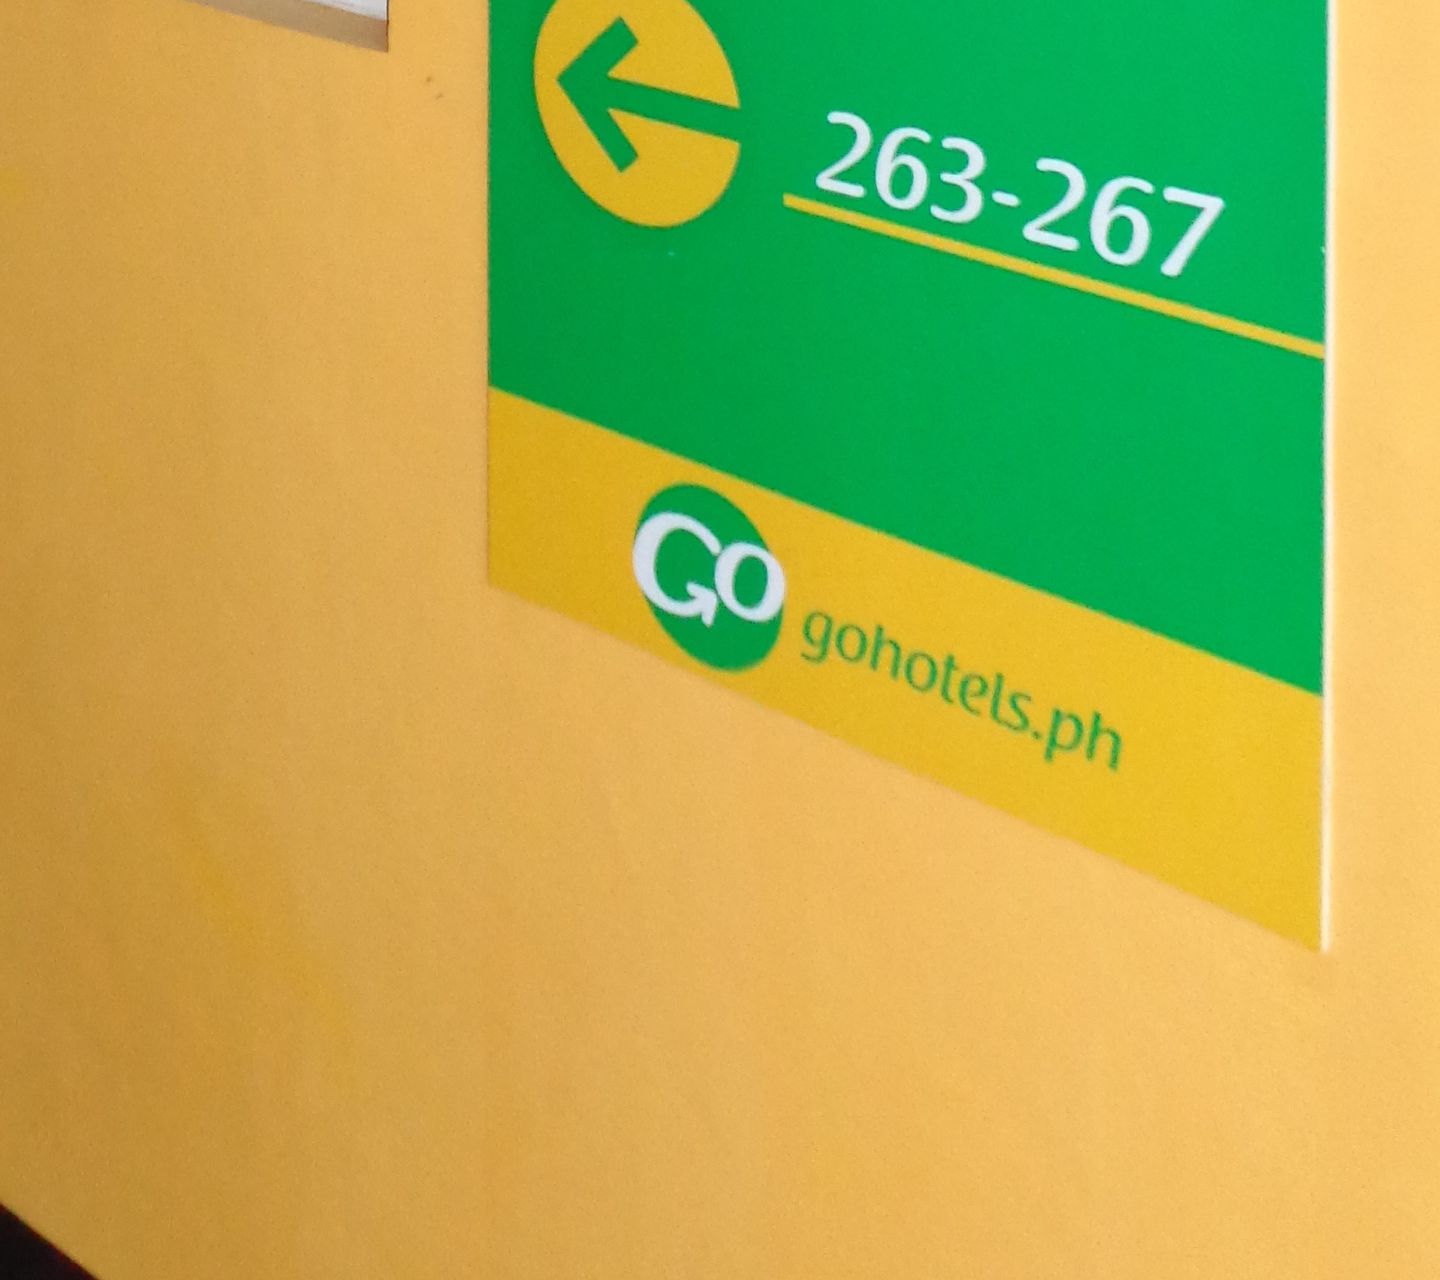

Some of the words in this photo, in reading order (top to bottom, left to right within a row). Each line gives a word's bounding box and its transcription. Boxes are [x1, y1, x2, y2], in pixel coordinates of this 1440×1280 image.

[813, 109, 1225, 279] 263-267
[631, 510, 787, 627] GO
[800, 608, 1123, 772] gohotels.ph
